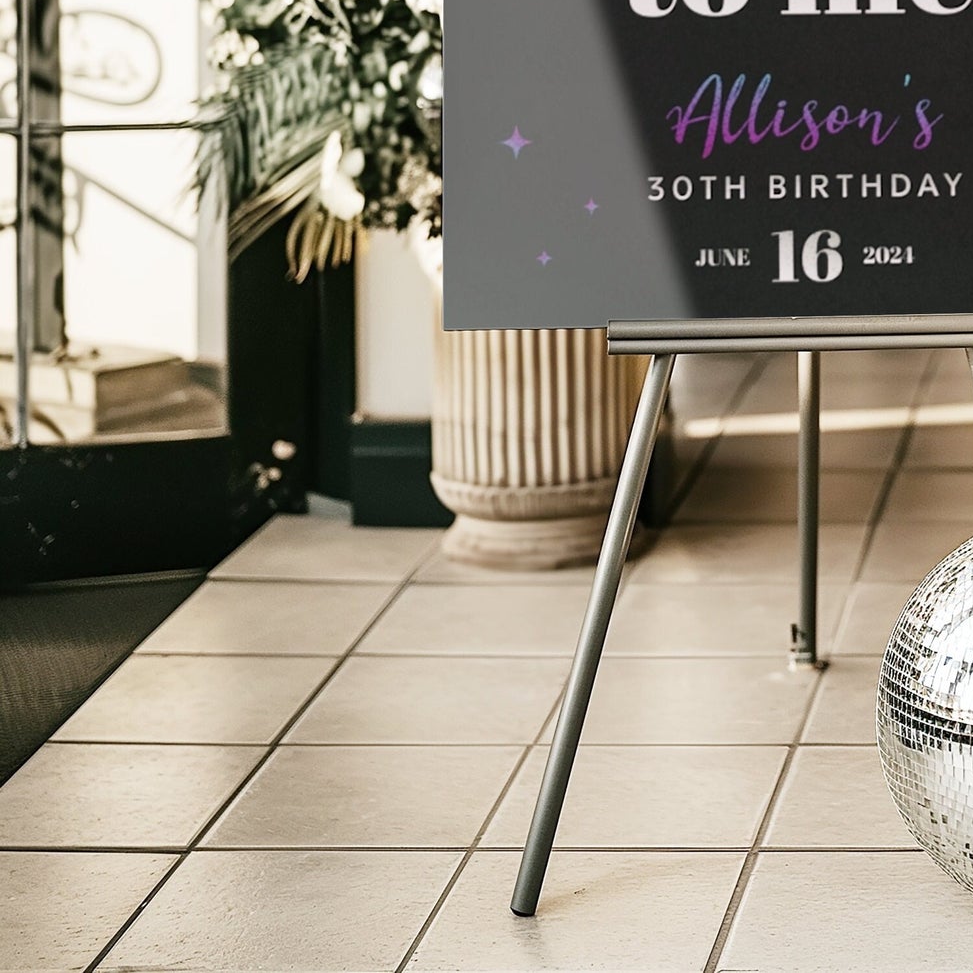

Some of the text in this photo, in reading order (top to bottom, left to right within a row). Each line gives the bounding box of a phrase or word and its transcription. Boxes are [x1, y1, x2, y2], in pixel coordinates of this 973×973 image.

[665, 73, 944, 159] Allison's
[647, 172, 963, 202] 30TH BIRTHDAY
[694, 229, 915, 284] JUNE 16 2024
